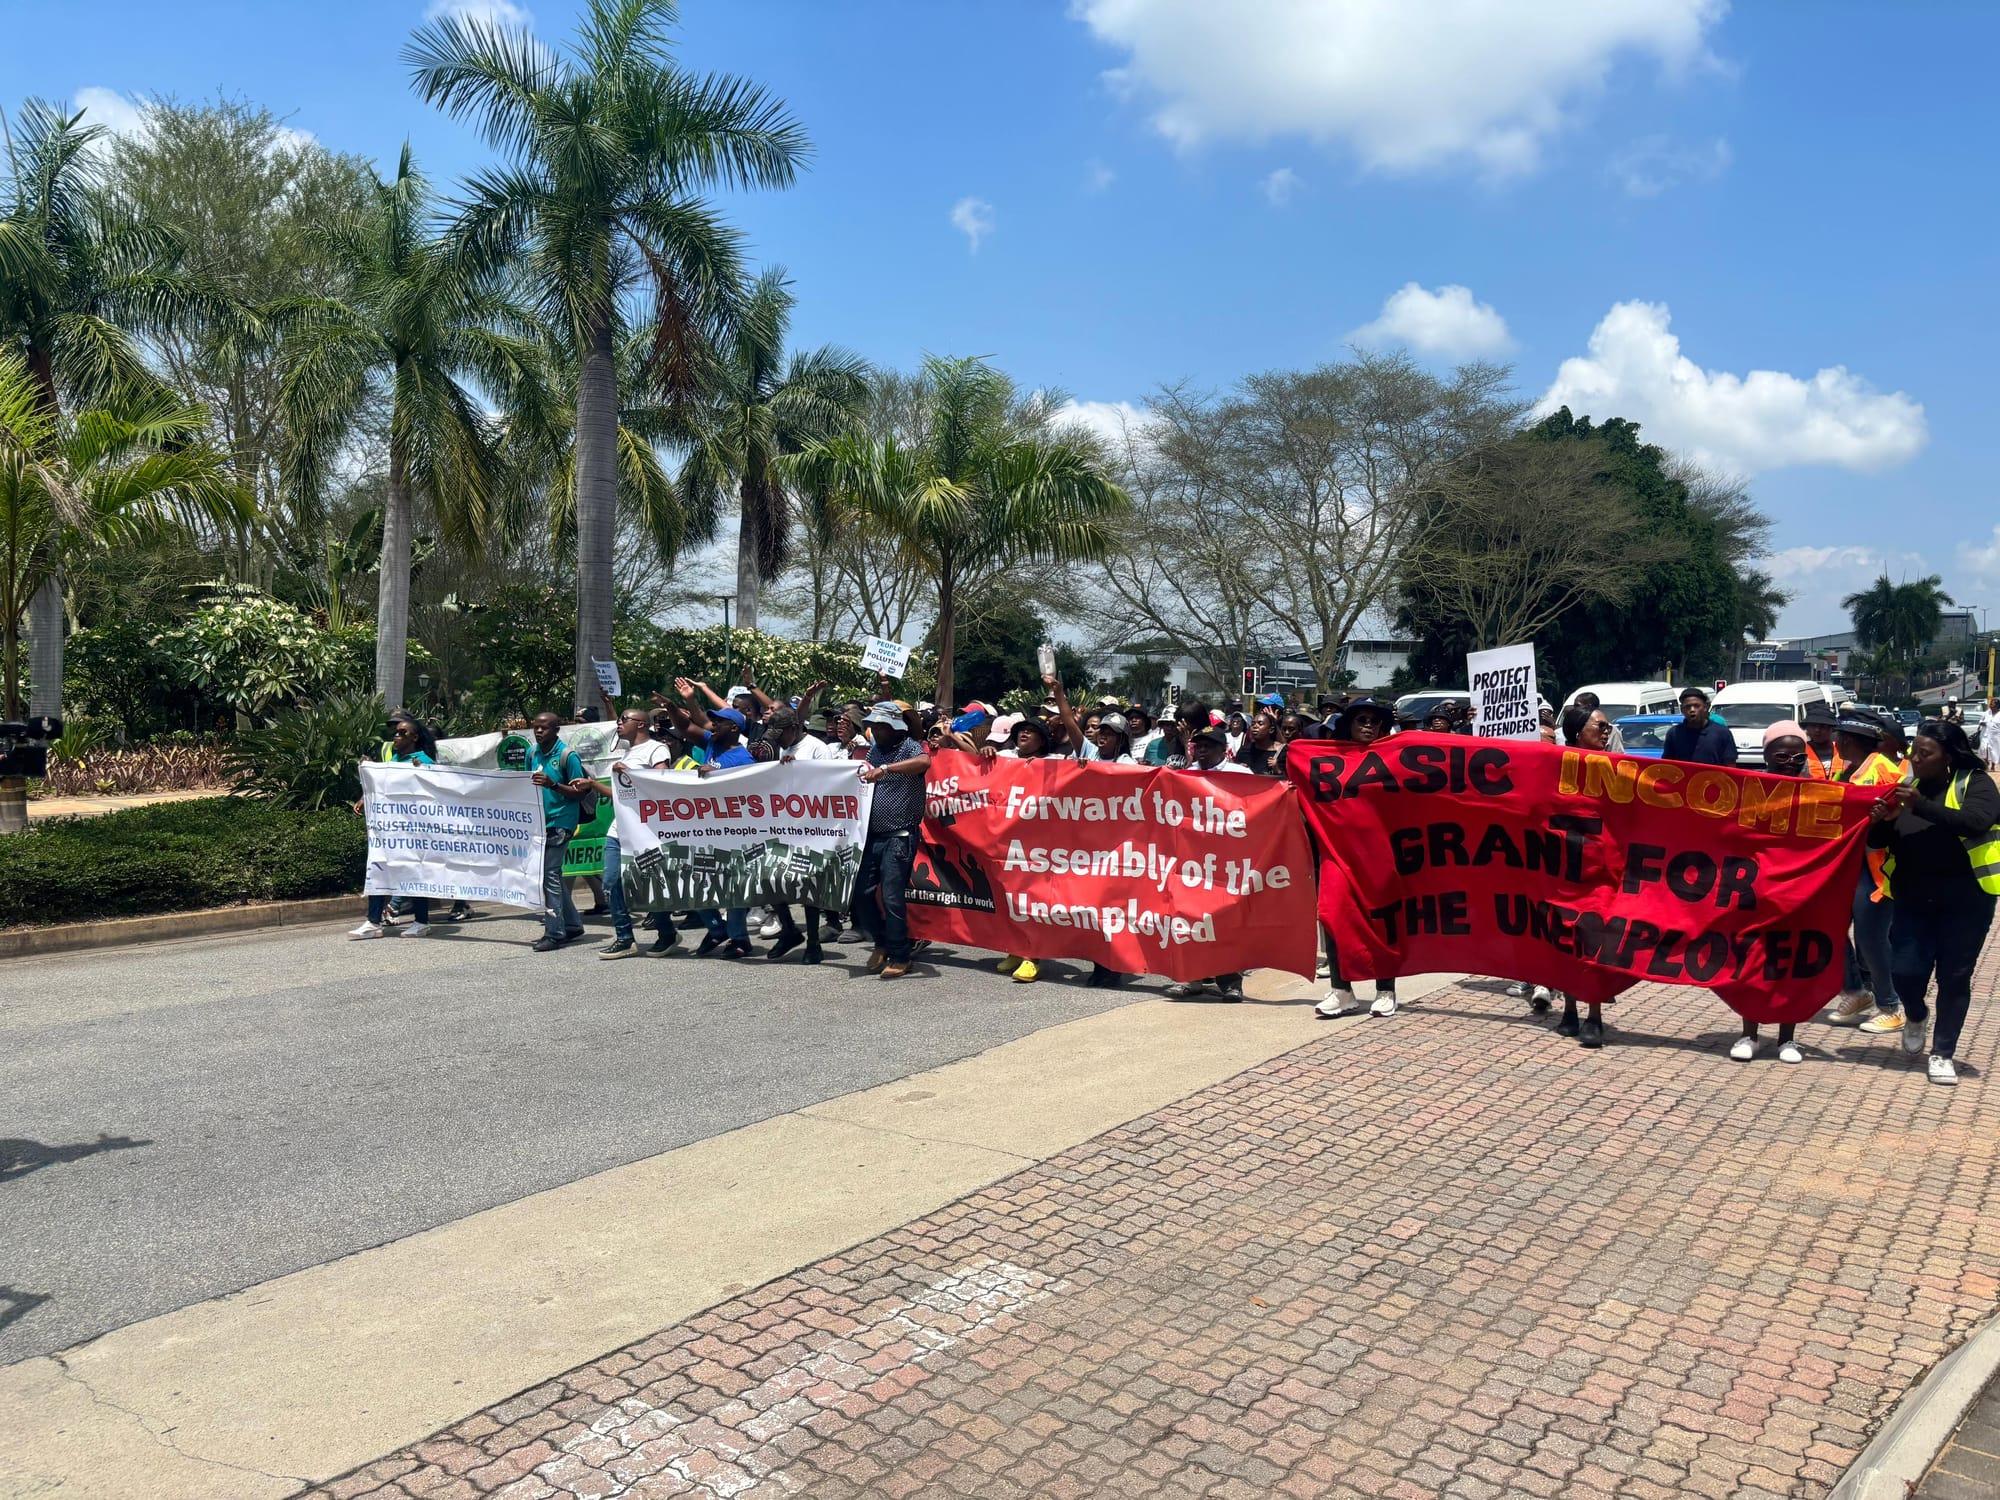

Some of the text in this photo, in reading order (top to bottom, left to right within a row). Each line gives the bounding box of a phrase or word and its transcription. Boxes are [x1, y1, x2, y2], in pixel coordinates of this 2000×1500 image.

[877, 640, 902, 652] PEOPLE
[878, 648, 896, 658] OVER
[867, 651, 904, 668] POLLUTION
[1473, 666, 1531, 691] PROTECT
[1483, 684, 1527, 706] HUMAN
[1484, 700, 1529, 722] RIGHTS
[1479, 718, 1536, 738] DEFENDERS
[1310, 745, 1845, 839] BASIC INCOME
[420, 804, 444, 817] OUR
[446, 805, 485, 819] WATER
[487, 808, 533, 824] SOURCES
[639, 795, 765, 824] PEOPLE'S
[769, 794, 859, 821] POWER
[1005, 785, 1247, 838] Forward to the
[377, 820, 455, 835] SUSTAINABLE
[457, 823, 530, 841] LIVELIHOODS
[658, 830, 690, 840] Power
[693, 829, 703, 837] to
[705, 827, 722, 836] the
[724, 826, 757, 837] People
[769, 826, 786, 836] Not
[788, 826, 803, 836] the
[805, 826, 847, 838] Polluters!
[382, 838, 429, 850] FUTURE
[431, 840, 510, 856] GENERATIONS
[1003, 839, 1292, 896] Assembly of the
[1390, 815, 1760, 911] GRANT FOR
[399, 881, 429, 893] WATER
[429, 883, 437, 893] IS
[460, 885, 489, 896] WATER
[490, 887, 498, 897] IS
[500, 888, 527, 900] DIGNITY
[919, 890, 934, 901] the
[936, 892, 960, 905] right
[963, 895, 973, 905] to
[974, 898, 995, 909] work
[1005, 892, 1217, 949] Unemployed
[1370, 891, 1834, 982] THE UNEMPLOYED
